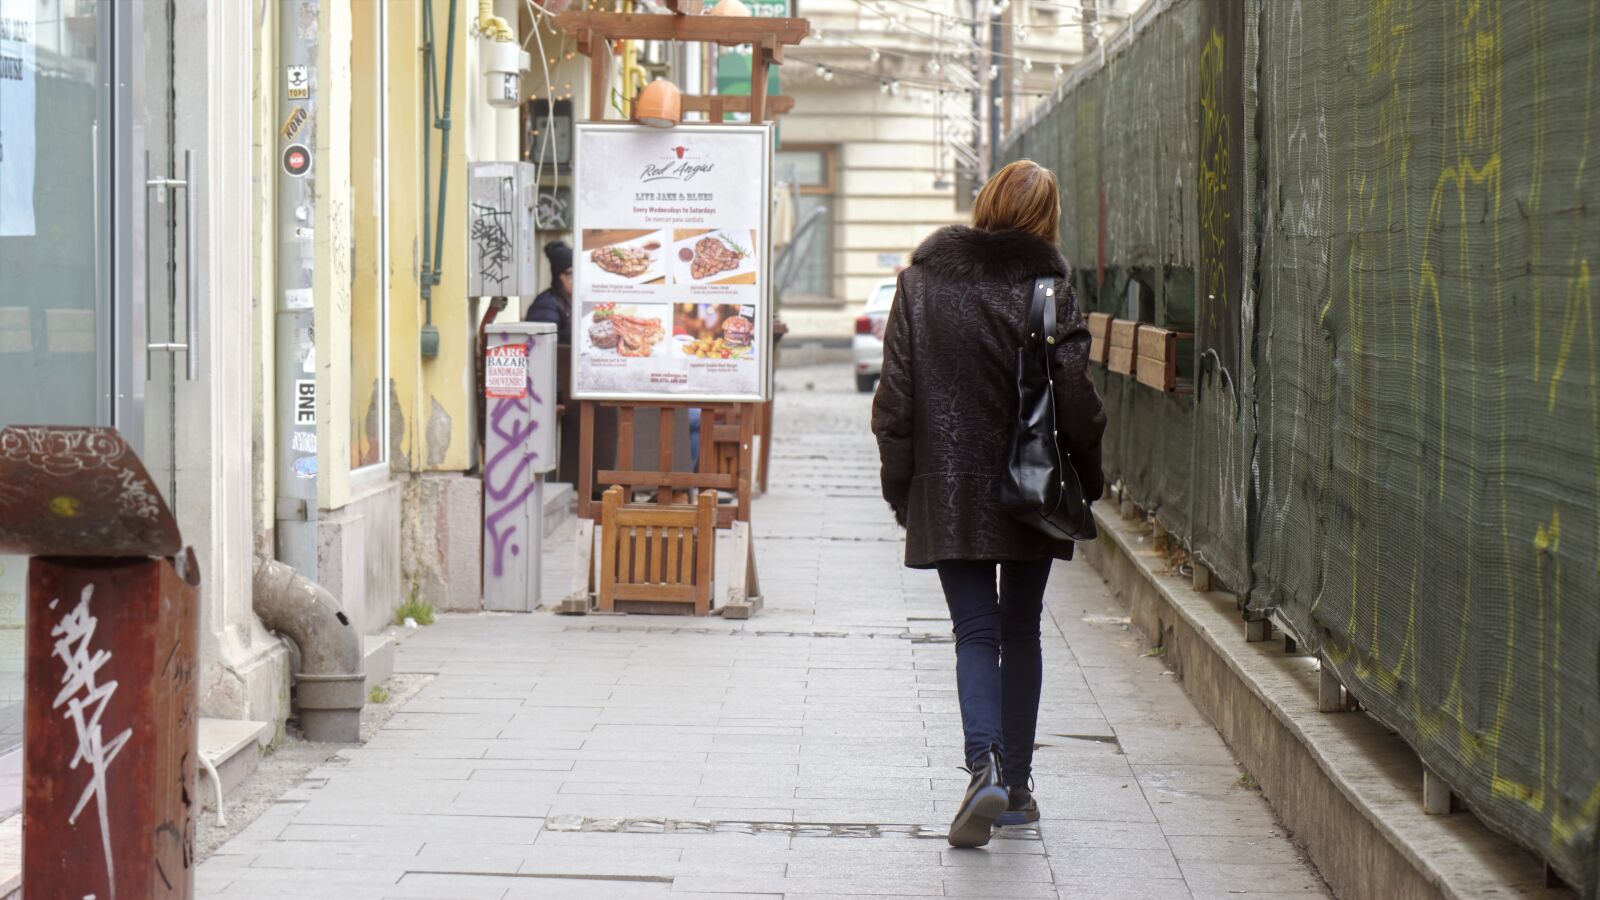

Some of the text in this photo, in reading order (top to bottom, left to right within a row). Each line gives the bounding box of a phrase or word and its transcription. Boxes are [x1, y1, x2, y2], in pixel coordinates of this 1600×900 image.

[640, 161, 714, 181] Red Angus
[635, 193, 655, 201] LIVE
[686, 193, 713, 201] BLUES
[633, 206, 647, 214] Every
[648, 206, 682, 214] Wednesdays
[689, 206, 716, 215] Saturdays
[488, 357, 526, 367] BAZAR
[488, 367, 525, 377] HANDMADE
[488, 377, 525, 386] SOUVENIRS
[299, 384, 315, 421] BNE
